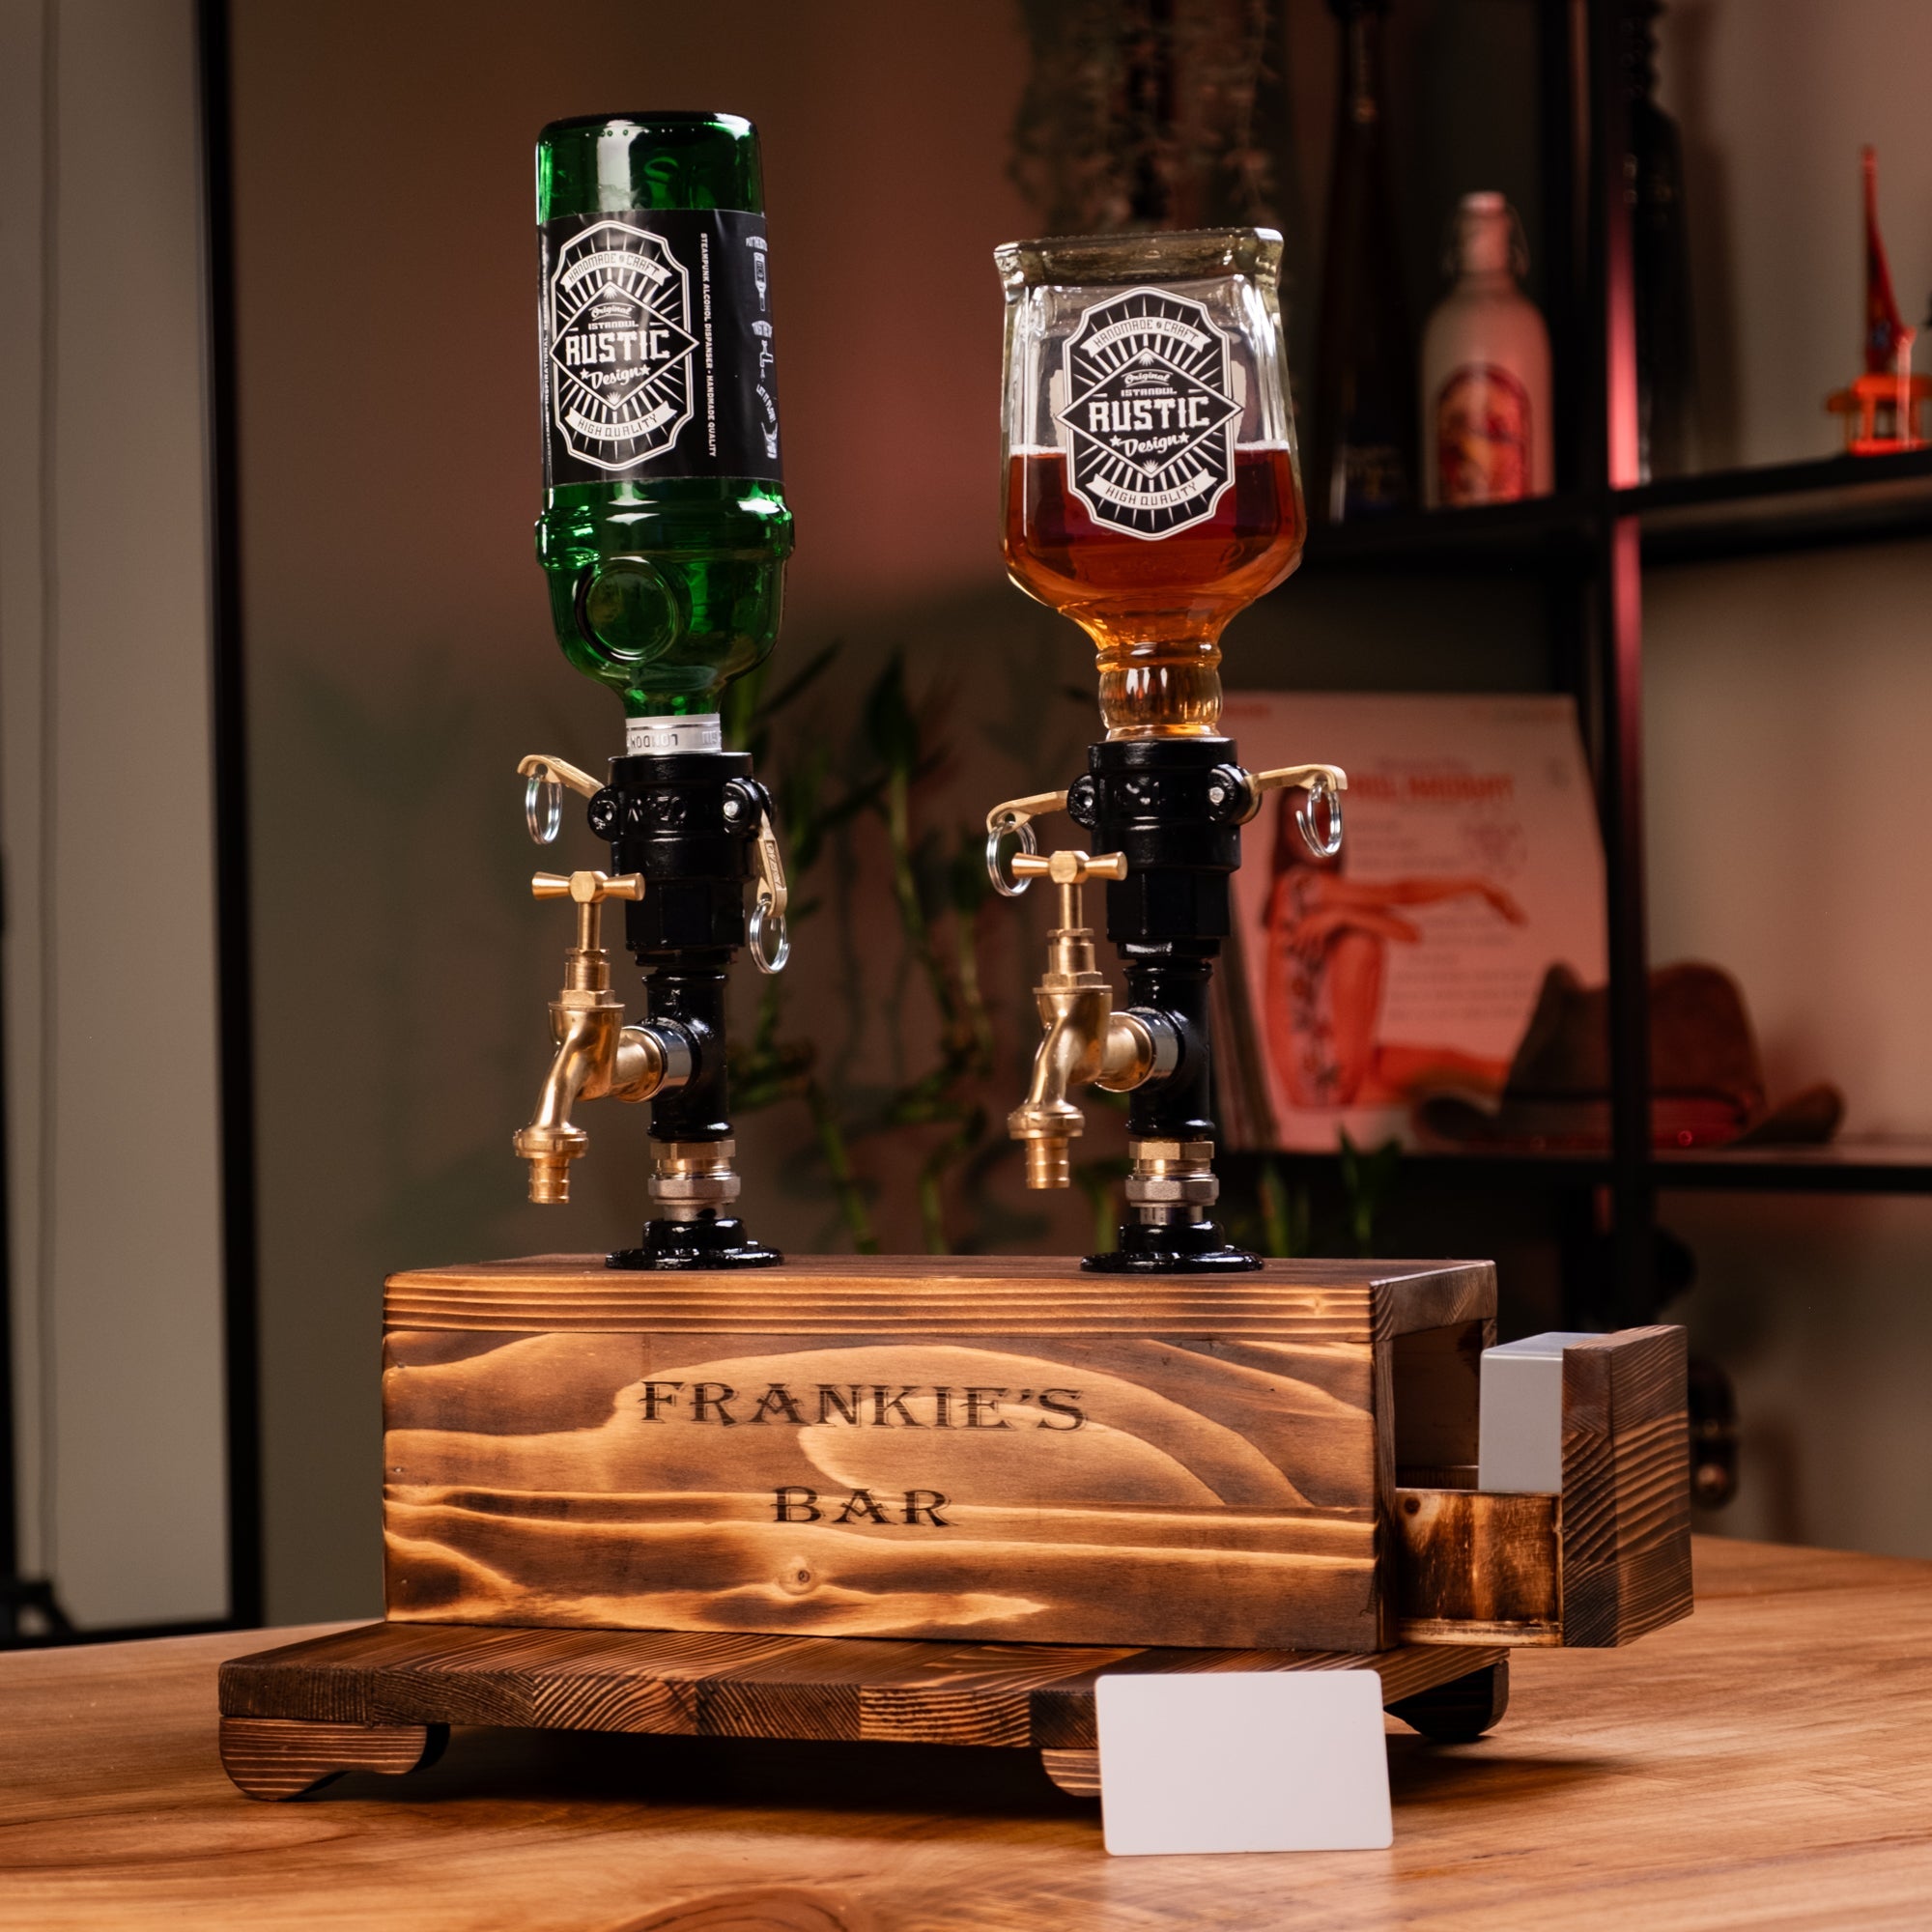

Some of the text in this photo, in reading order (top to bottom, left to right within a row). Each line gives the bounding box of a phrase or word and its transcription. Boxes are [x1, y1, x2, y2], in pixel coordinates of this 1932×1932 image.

[567, 253, 616, 283] HANDMADE
[626, 254, 660, 275] CRAFT
[591, 305, 633, 318] Original
[587, 320, 639, 330] ISTANBUL
[1093, 319, 1153, 348] HANDMADE
[1163, 321, 1200, 343] CRAFT
[565, 329, 670, 366] RUSTIC
[700, 233, 717, 457] STEAMPUNK ALCOHOL DISPANSER HANDMADE QUALITY
[587, 367, 641, 390] Design
[1124, 372, 1171, 384] Original
[1121, 387, 1178, 398] ISTANBUL
[576, 412, 658, 438] HIGH QUALITY
[1088, 396, 1210, 433] RUSTIC
[1119, 435, 1179, 458] Design
[1105, 482, 1197, 506] HIGH QUALITY
[630, 733, 679, 750] LONDON
[638, 1380, 1088, 1433] FRANKIE'S
[770, 1486, 958, 1527] BAR
